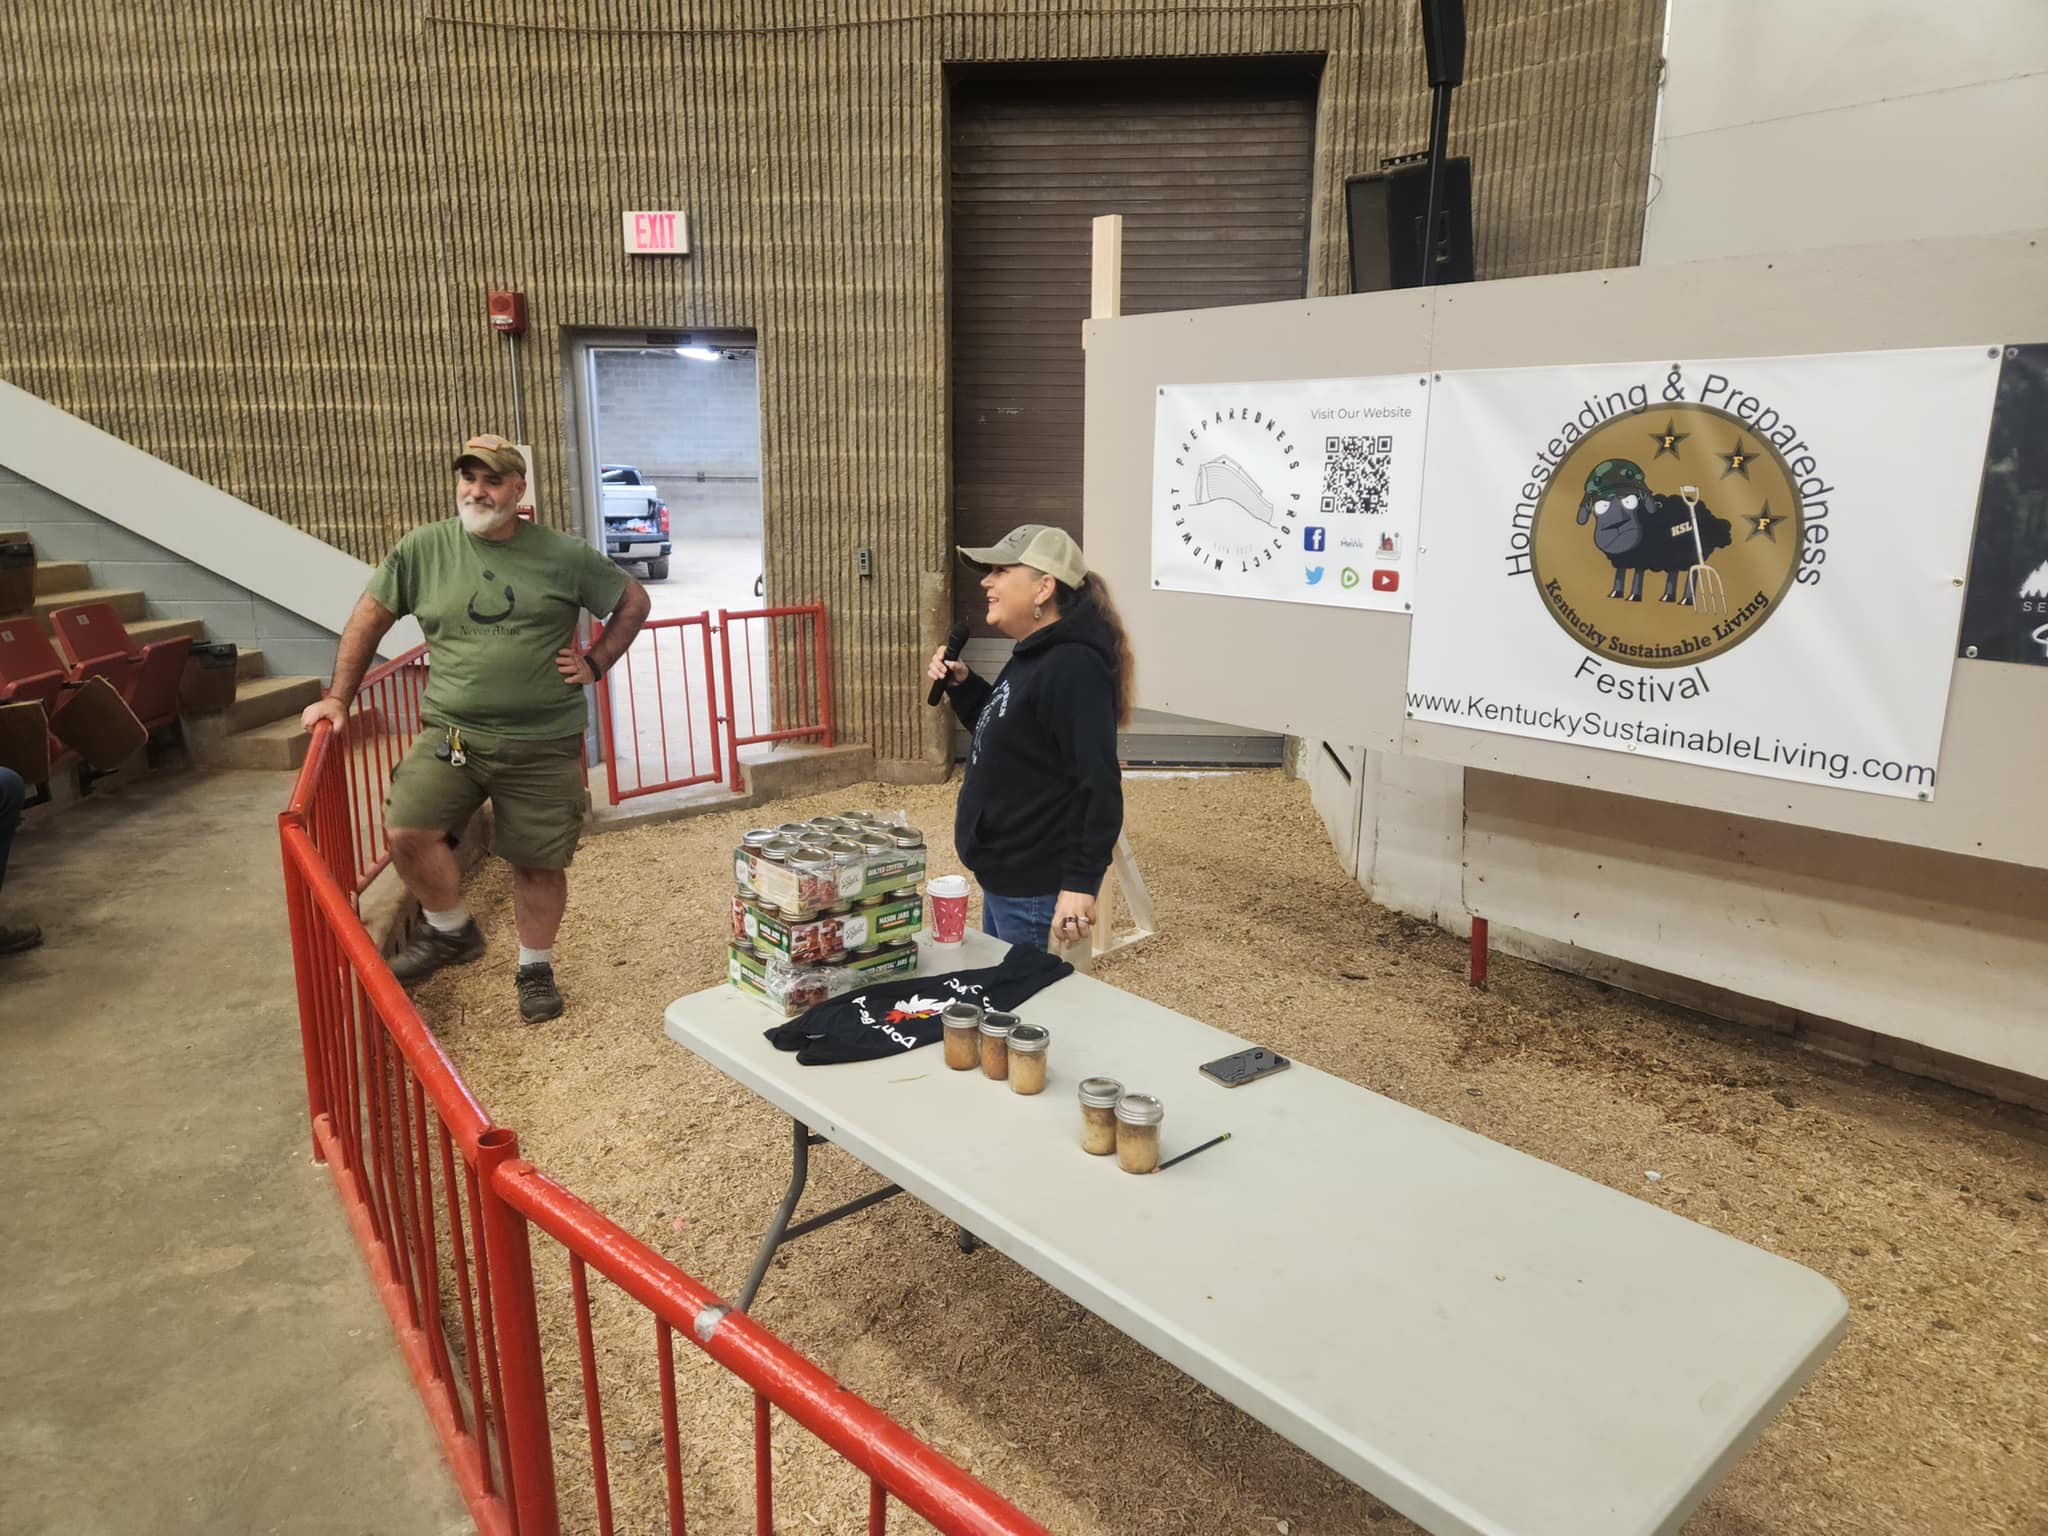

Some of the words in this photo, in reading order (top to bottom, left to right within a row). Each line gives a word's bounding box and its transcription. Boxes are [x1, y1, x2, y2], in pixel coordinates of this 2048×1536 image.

[634, 213, 676, 249] EXIT
[1310, 407, 1334, 420] Visit
[1337, 408, 1360, 419] Our
[1363, 406, 1412, 418] Website
[1176, 408, 1300, 470] PREPAREDNESS
[1664, 436, 1675, 448] F
[1505, 383, 1648, 577] Homesteading
[1662, 371, 1685, 402] &
[1700, 374, 1834, 586] Preparedness
[1732, 456, 1744, 468] F
[1671, 521, 1693, 537] KSL
[1758, 518, 1770, 530] F
[1546, 578, 1607, 649] Kentucky
[1608, 635, 1712, 659] Sustainable
[1712, 590, 1769, 641] Living
[1574, 655, 1710, 702] Festival
[1407, 692, 1935, 787] www.KentuckySustainableLiving.com
